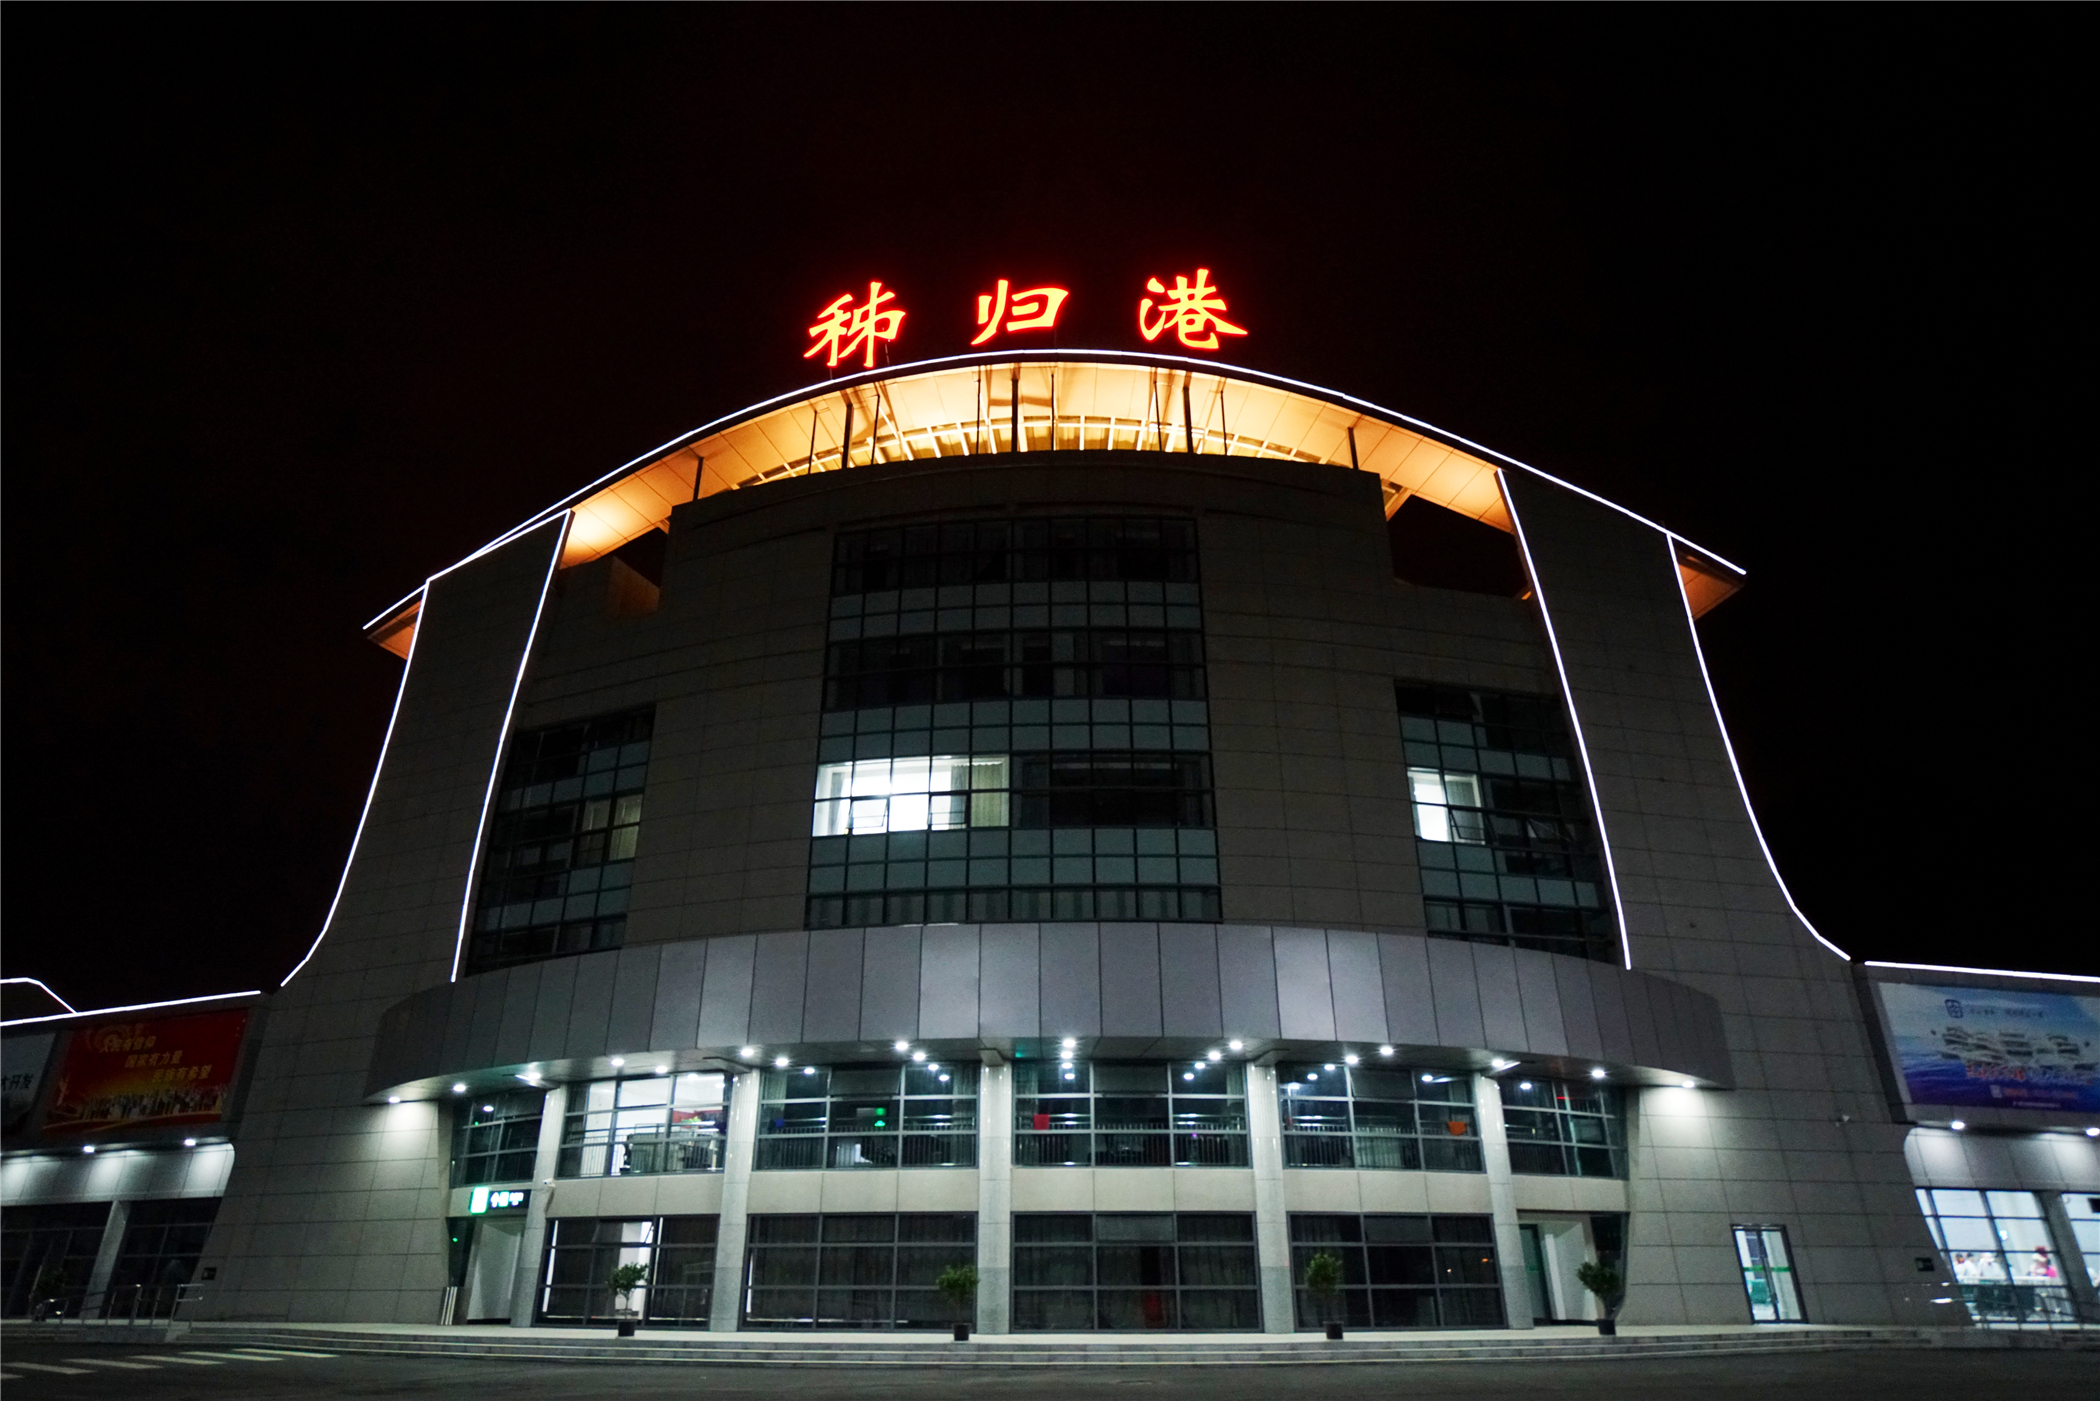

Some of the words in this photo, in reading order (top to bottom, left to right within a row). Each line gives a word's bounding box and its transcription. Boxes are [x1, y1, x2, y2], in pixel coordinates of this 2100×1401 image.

[803, 269, 1248, 368] 秭归港
[124, 1050, 183, 1068] 国家有力量
